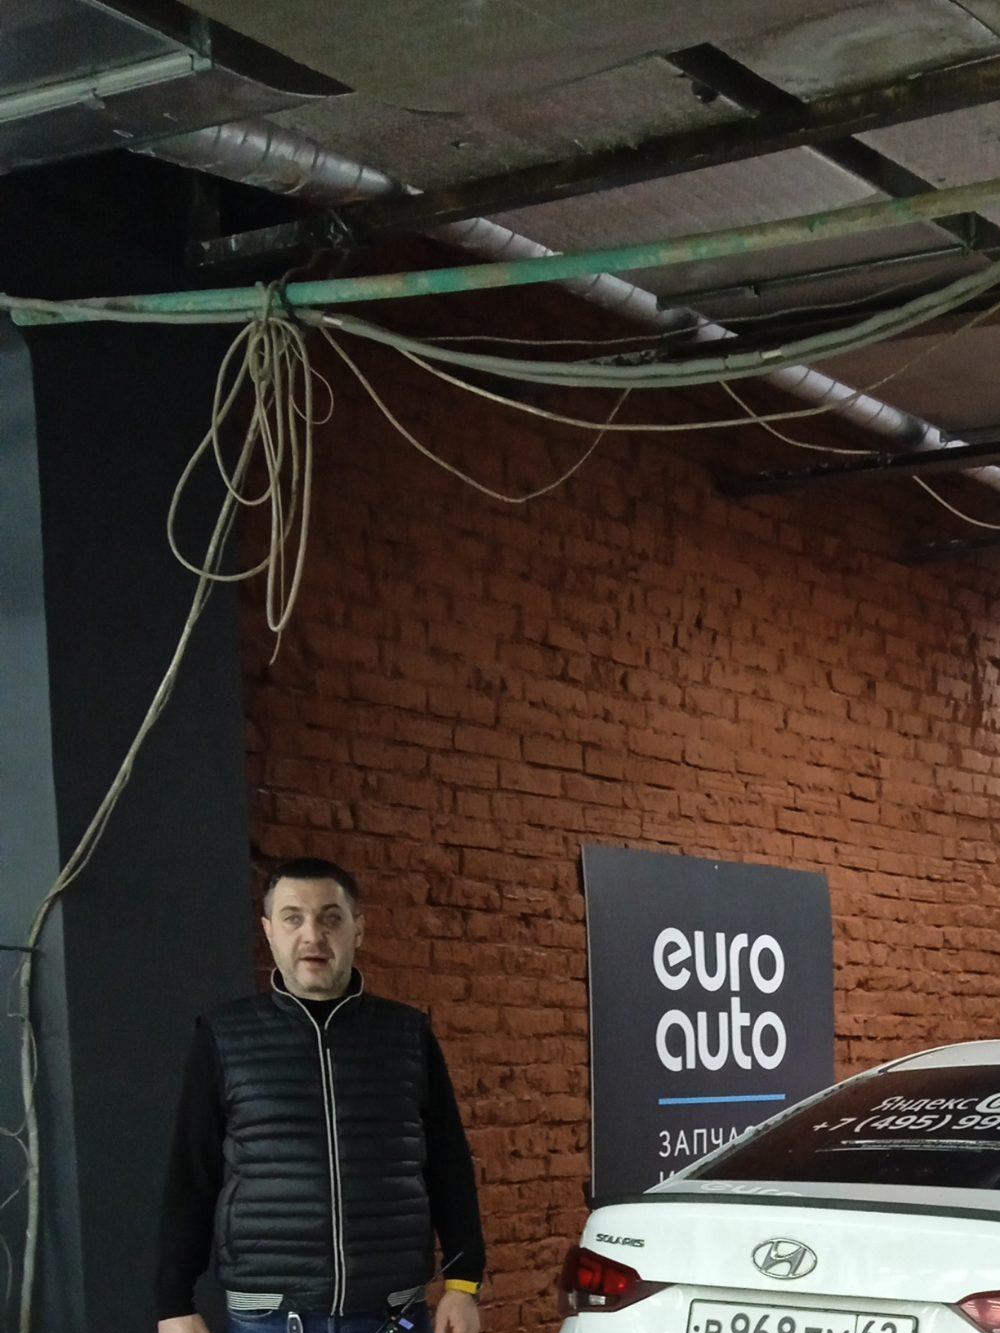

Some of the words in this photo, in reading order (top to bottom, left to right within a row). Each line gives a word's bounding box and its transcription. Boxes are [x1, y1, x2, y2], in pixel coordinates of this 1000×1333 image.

[653, 927, 785, 994] euro
[655, 996, 787, 1072] auto
[870, 1096, 979, 1112] Яндекс
[812, 1117, 857, 1132] +7
[854, 1114, 952, 1133] (495)
[596, 1233, 645, 1248] SOLARIS
